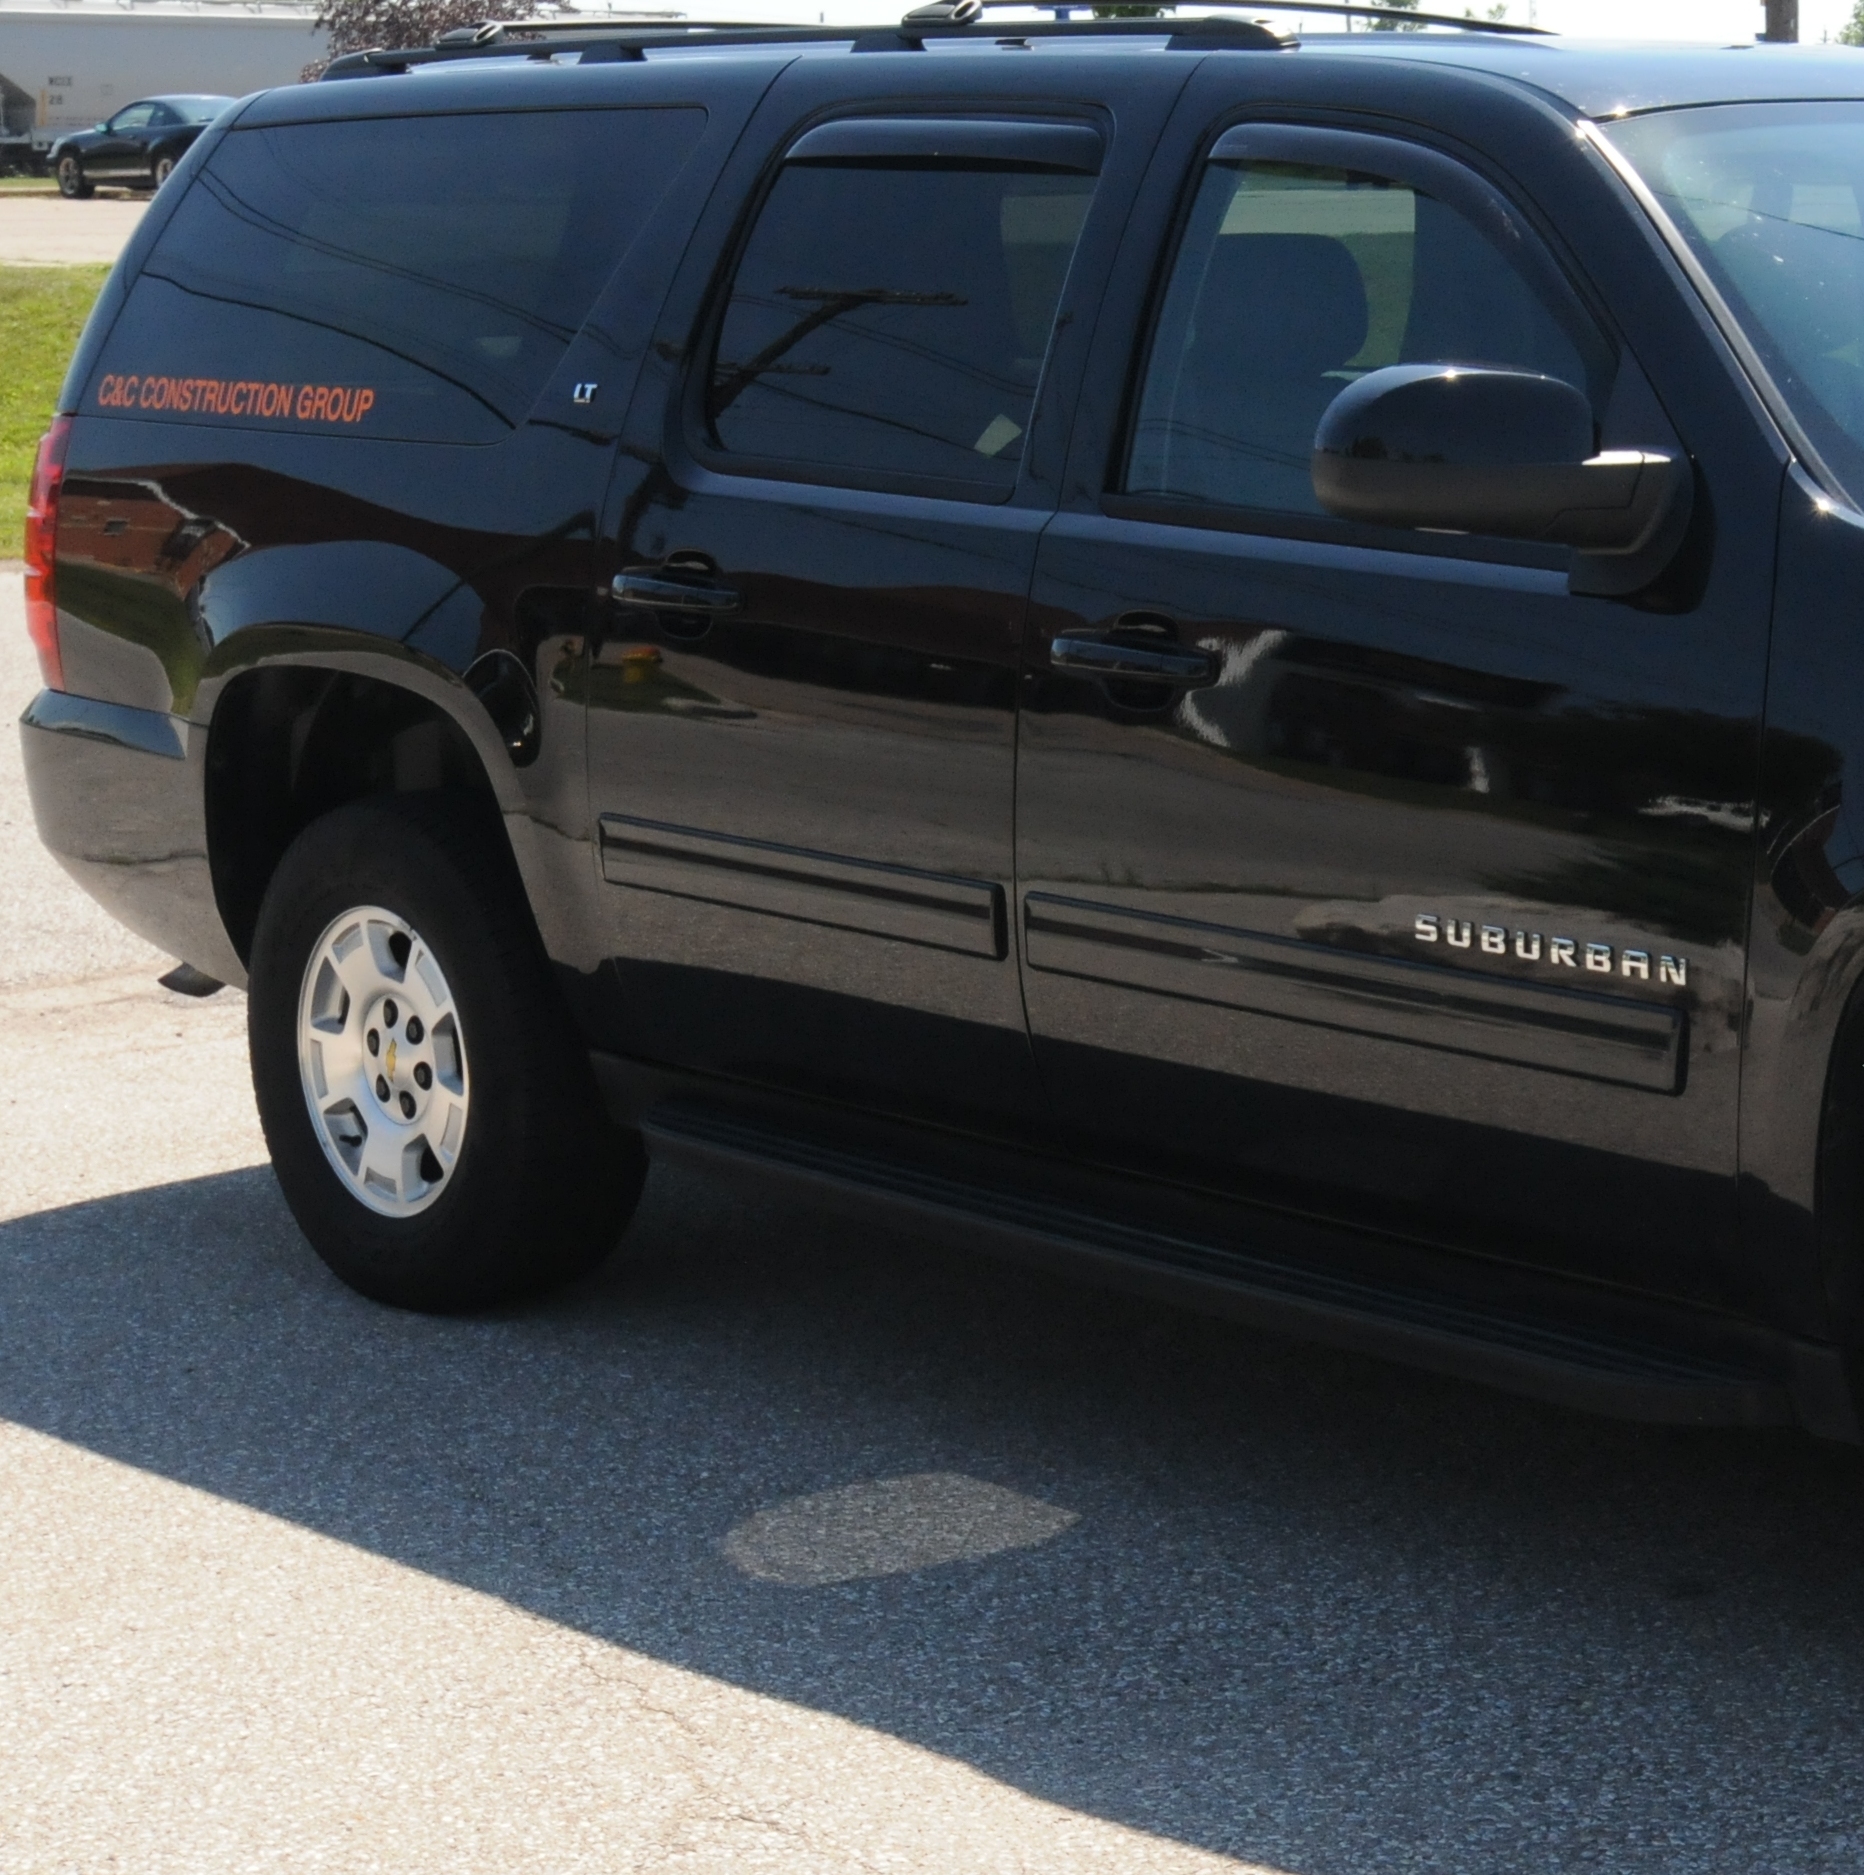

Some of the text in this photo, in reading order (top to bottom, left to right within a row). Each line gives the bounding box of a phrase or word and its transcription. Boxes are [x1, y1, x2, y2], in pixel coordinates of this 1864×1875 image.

[98, 374, 375, 423] C&C CONSTRUCTION GROUP
[573, 383, 598, 403] LT
[1414, 913, 1688, 987] SUBURBAN
